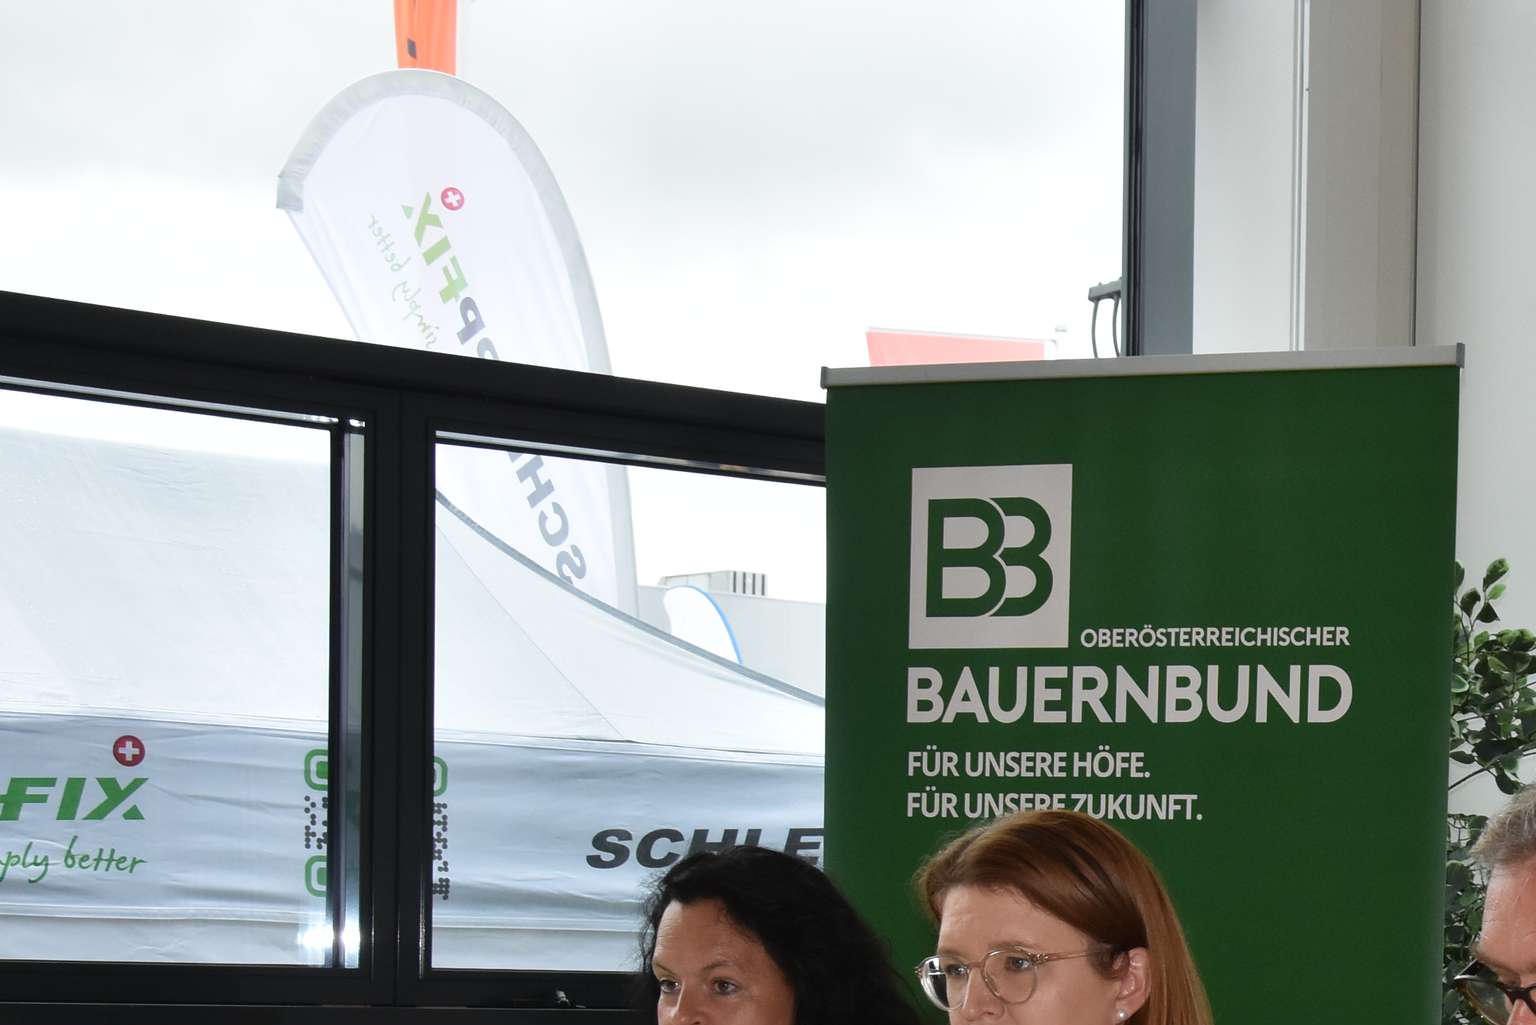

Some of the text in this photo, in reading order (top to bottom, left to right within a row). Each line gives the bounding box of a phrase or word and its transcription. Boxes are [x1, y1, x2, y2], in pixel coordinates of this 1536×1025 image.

[925, 496, 1054, 617] BB
[1079, 624, 1351, 649] OBERÖSTERREICHISCHER
[906, 664, 1353, 723] BAUERNBUND
[907, 745, 1151, 778] FÜR UNSERE HÖFE.
[906, 786, 959, 818] FÜR
[1071, 793, 1203, 820] ZUKUNFT.
[0, 835, 149, 884] ply better
